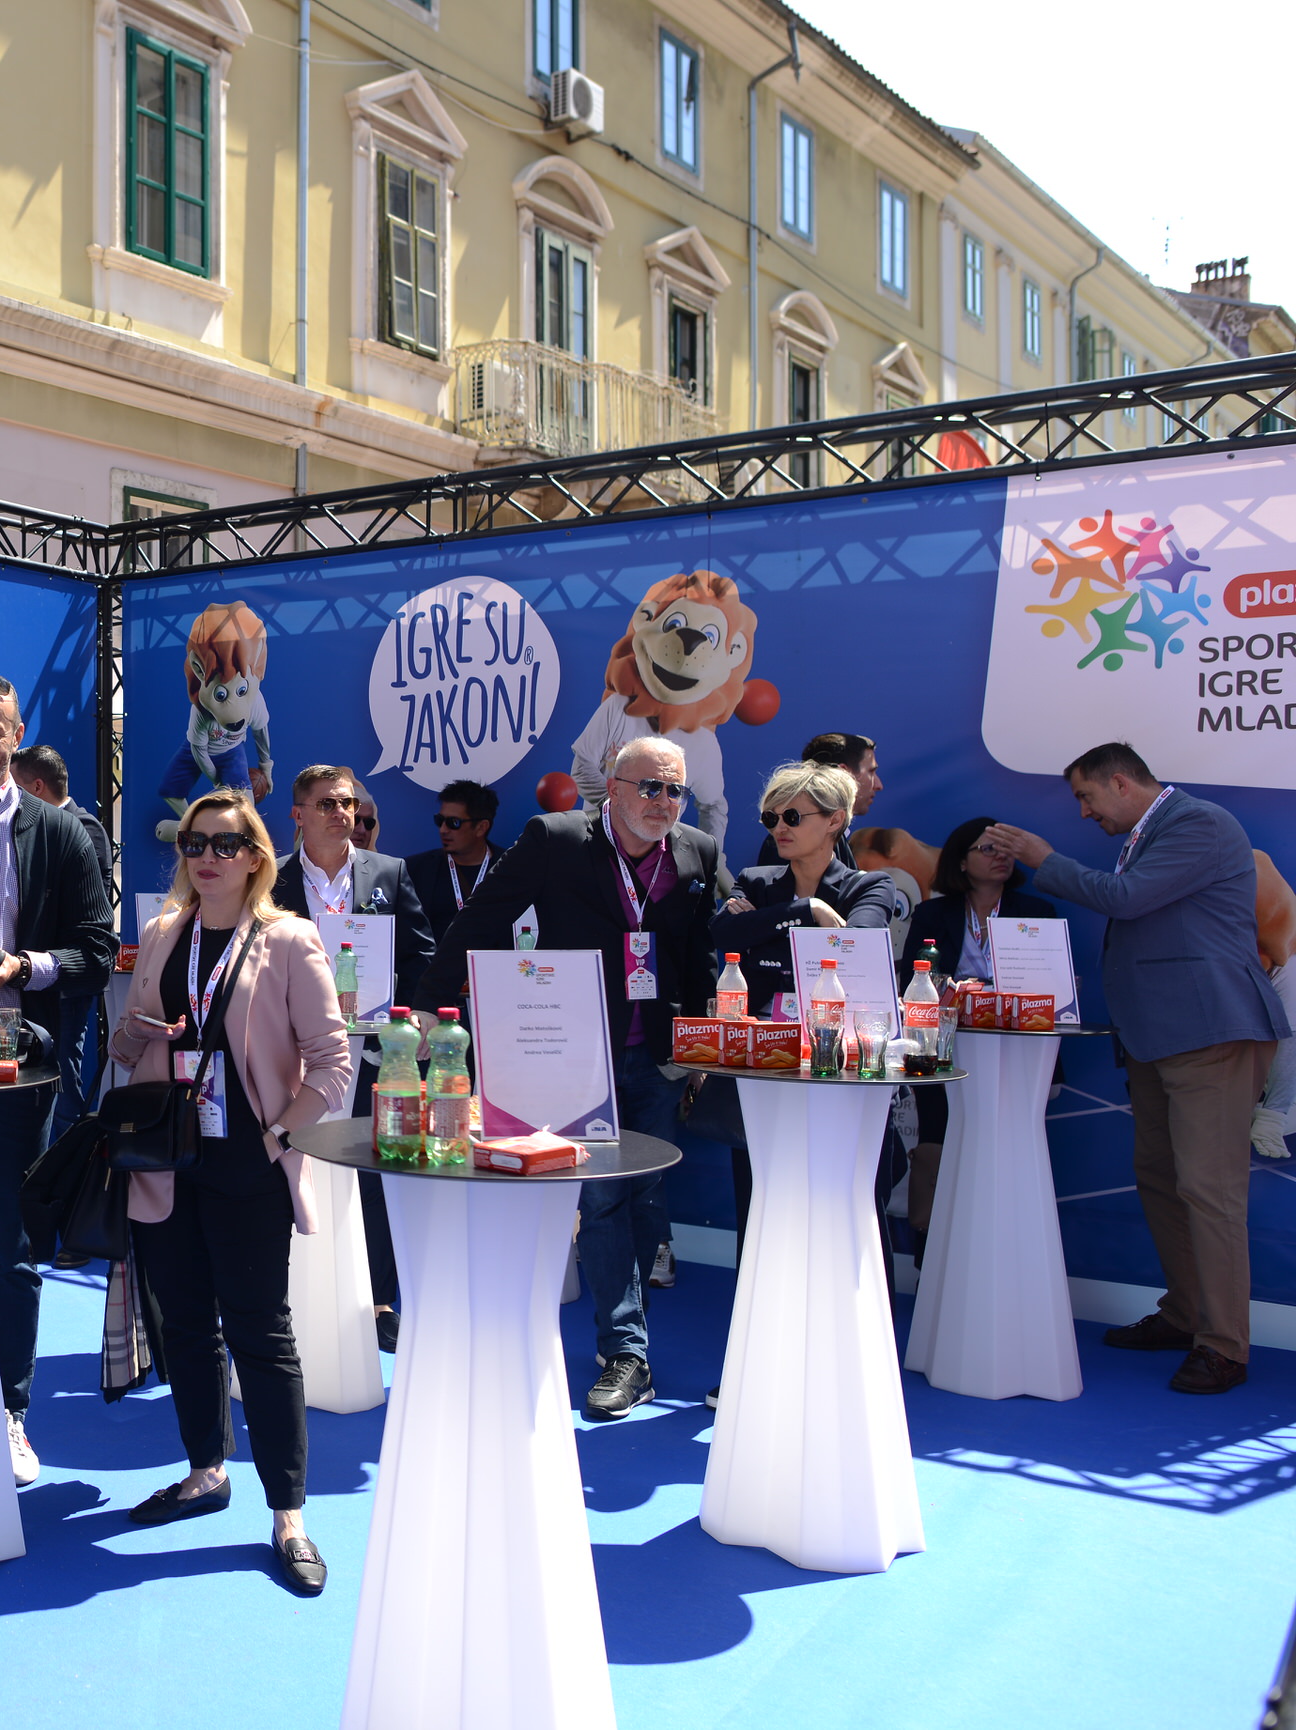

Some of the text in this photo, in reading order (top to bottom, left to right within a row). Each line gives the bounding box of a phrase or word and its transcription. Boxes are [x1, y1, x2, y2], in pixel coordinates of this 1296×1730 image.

[391, 592, 526, 688] IGRE SU
[1198, 668, 1283, 698] IGRE
[400, 661, 541, 773] ZAKON!
[636, 958, 646, 967] VIP
[1022, 999, 1052, 1011] plazma
[756, 1029, 798, 1043] plazma
